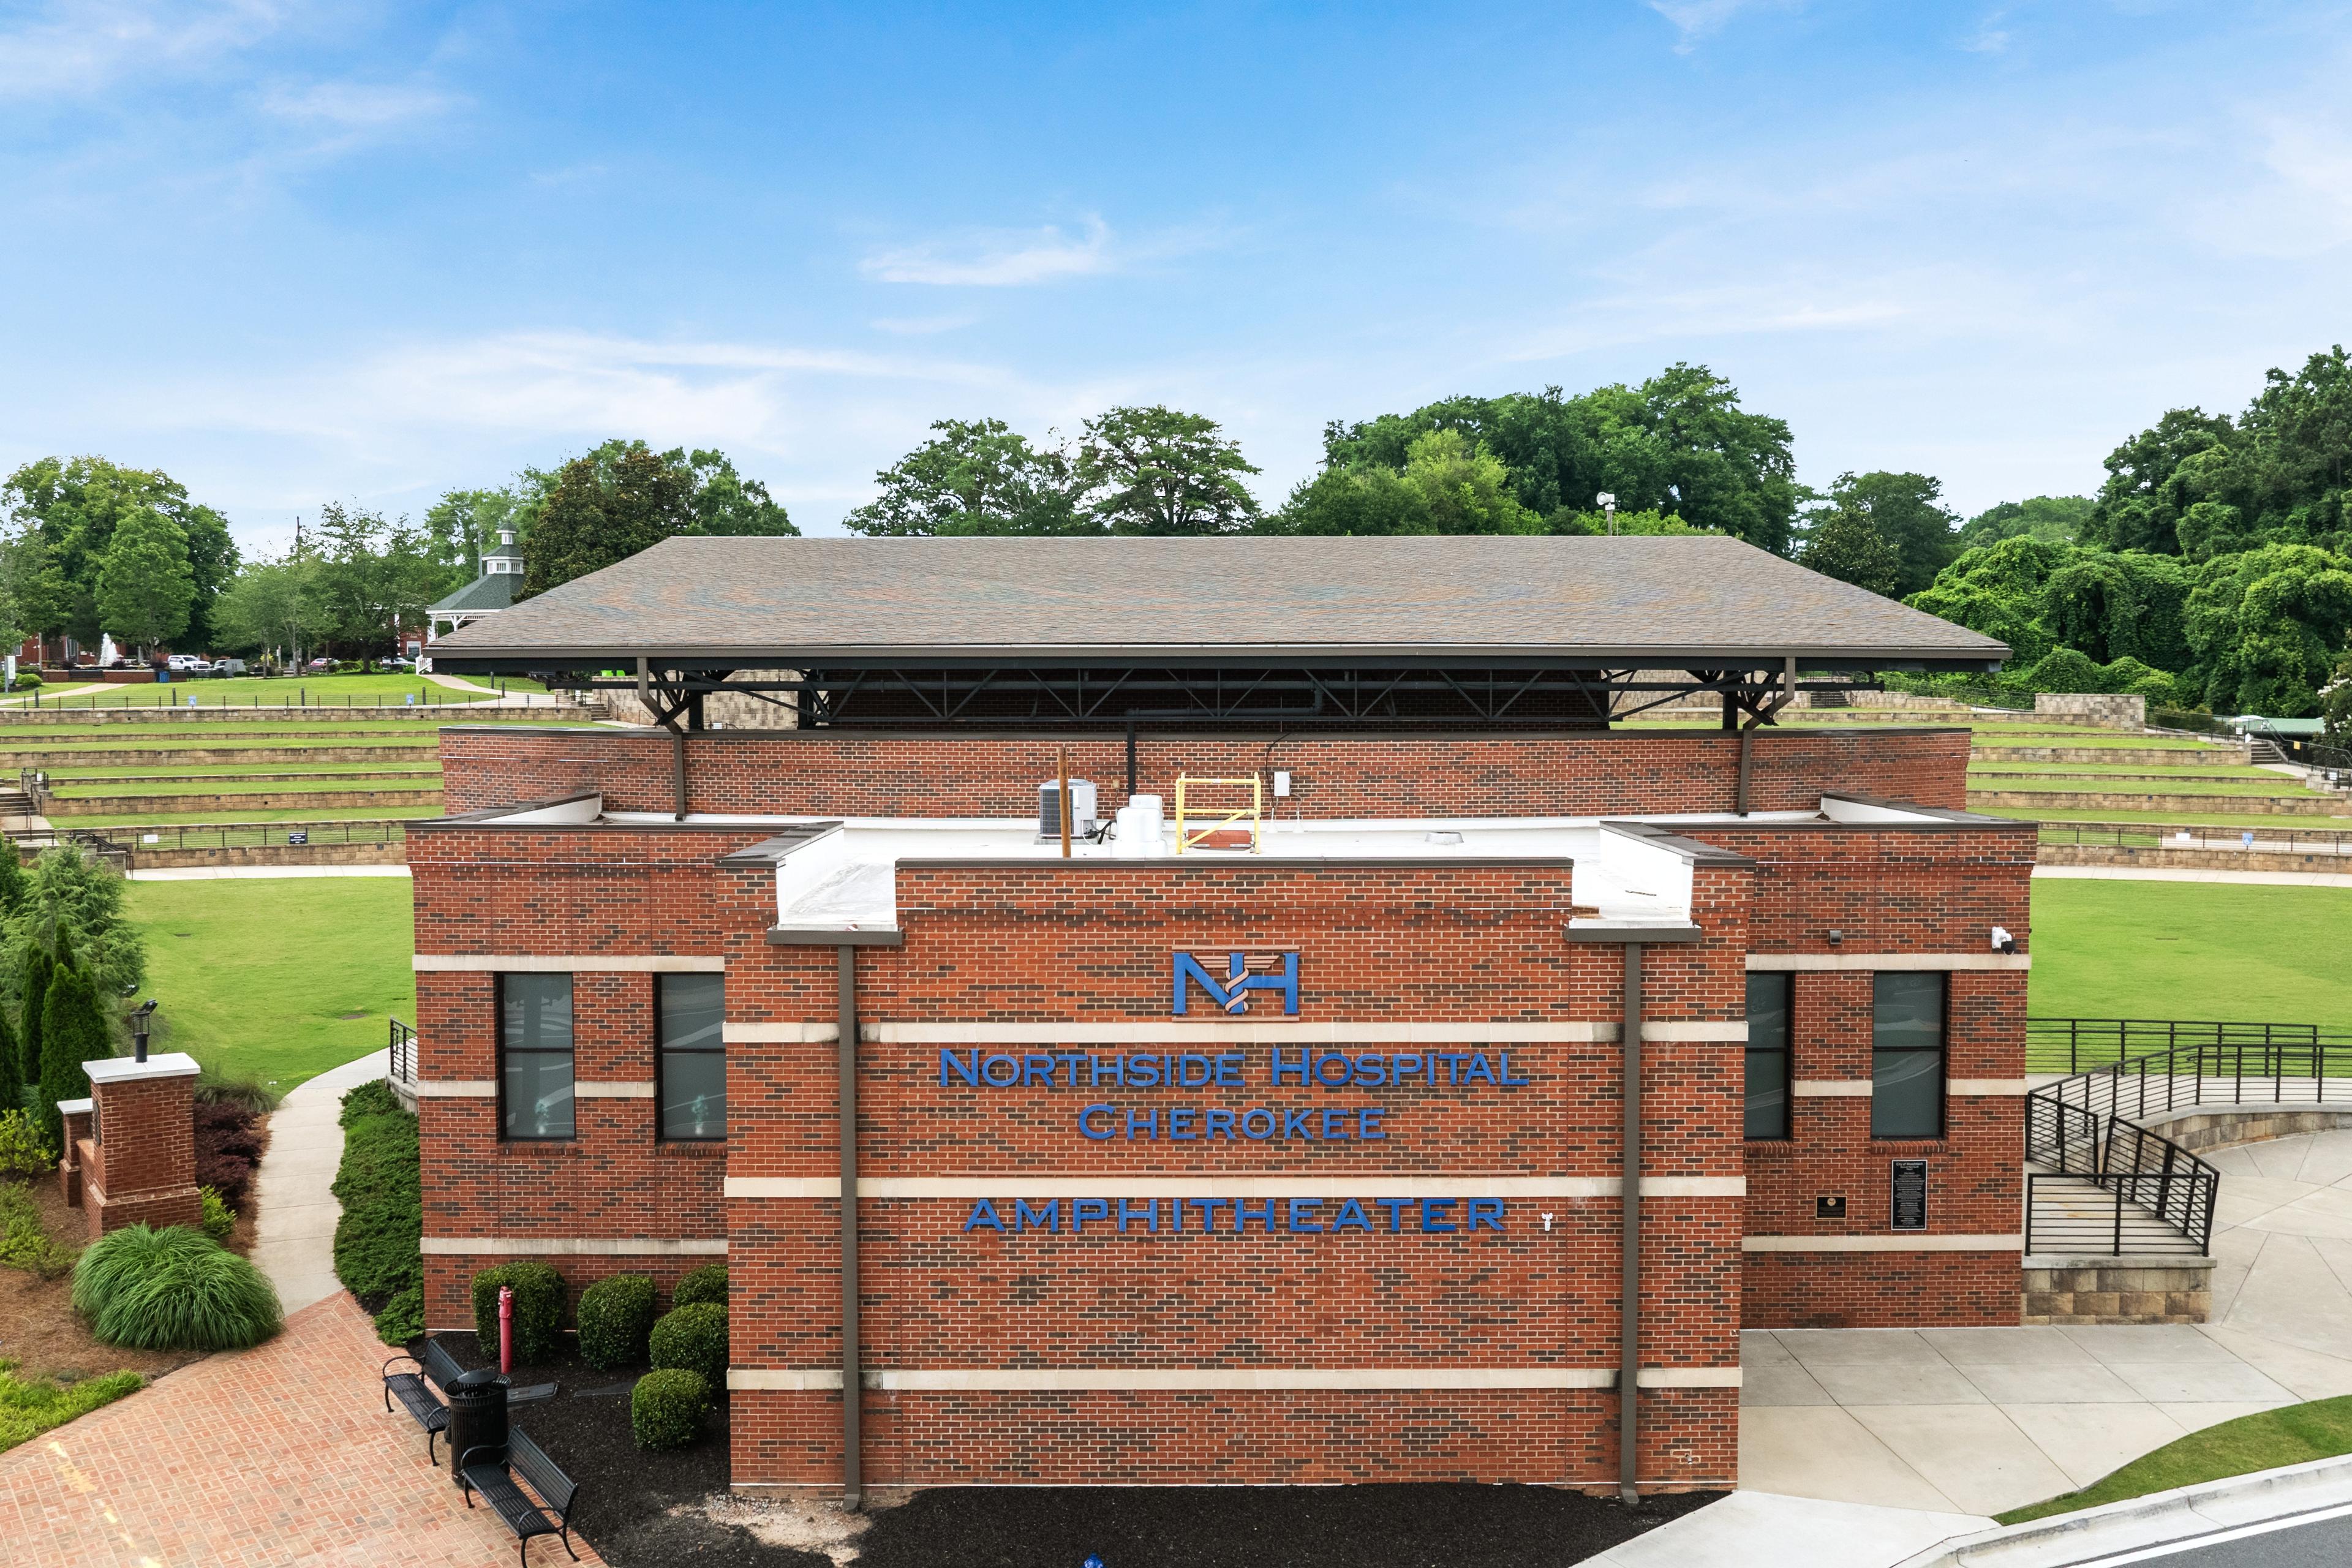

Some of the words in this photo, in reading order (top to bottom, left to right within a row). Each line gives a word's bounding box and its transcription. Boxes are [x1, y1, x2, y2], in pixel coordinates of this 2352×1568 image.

[1173, 953, 1298, 1014] NH
[940, 1048, 1245, 1087] NORTHSIDE
[1272, 1048, 1529, 1087] HOSPITAL
[1079, 1104, 1386, 1140] CHEROKEE
[964, 1198, 1505, 1232] AMPHITHEATER
